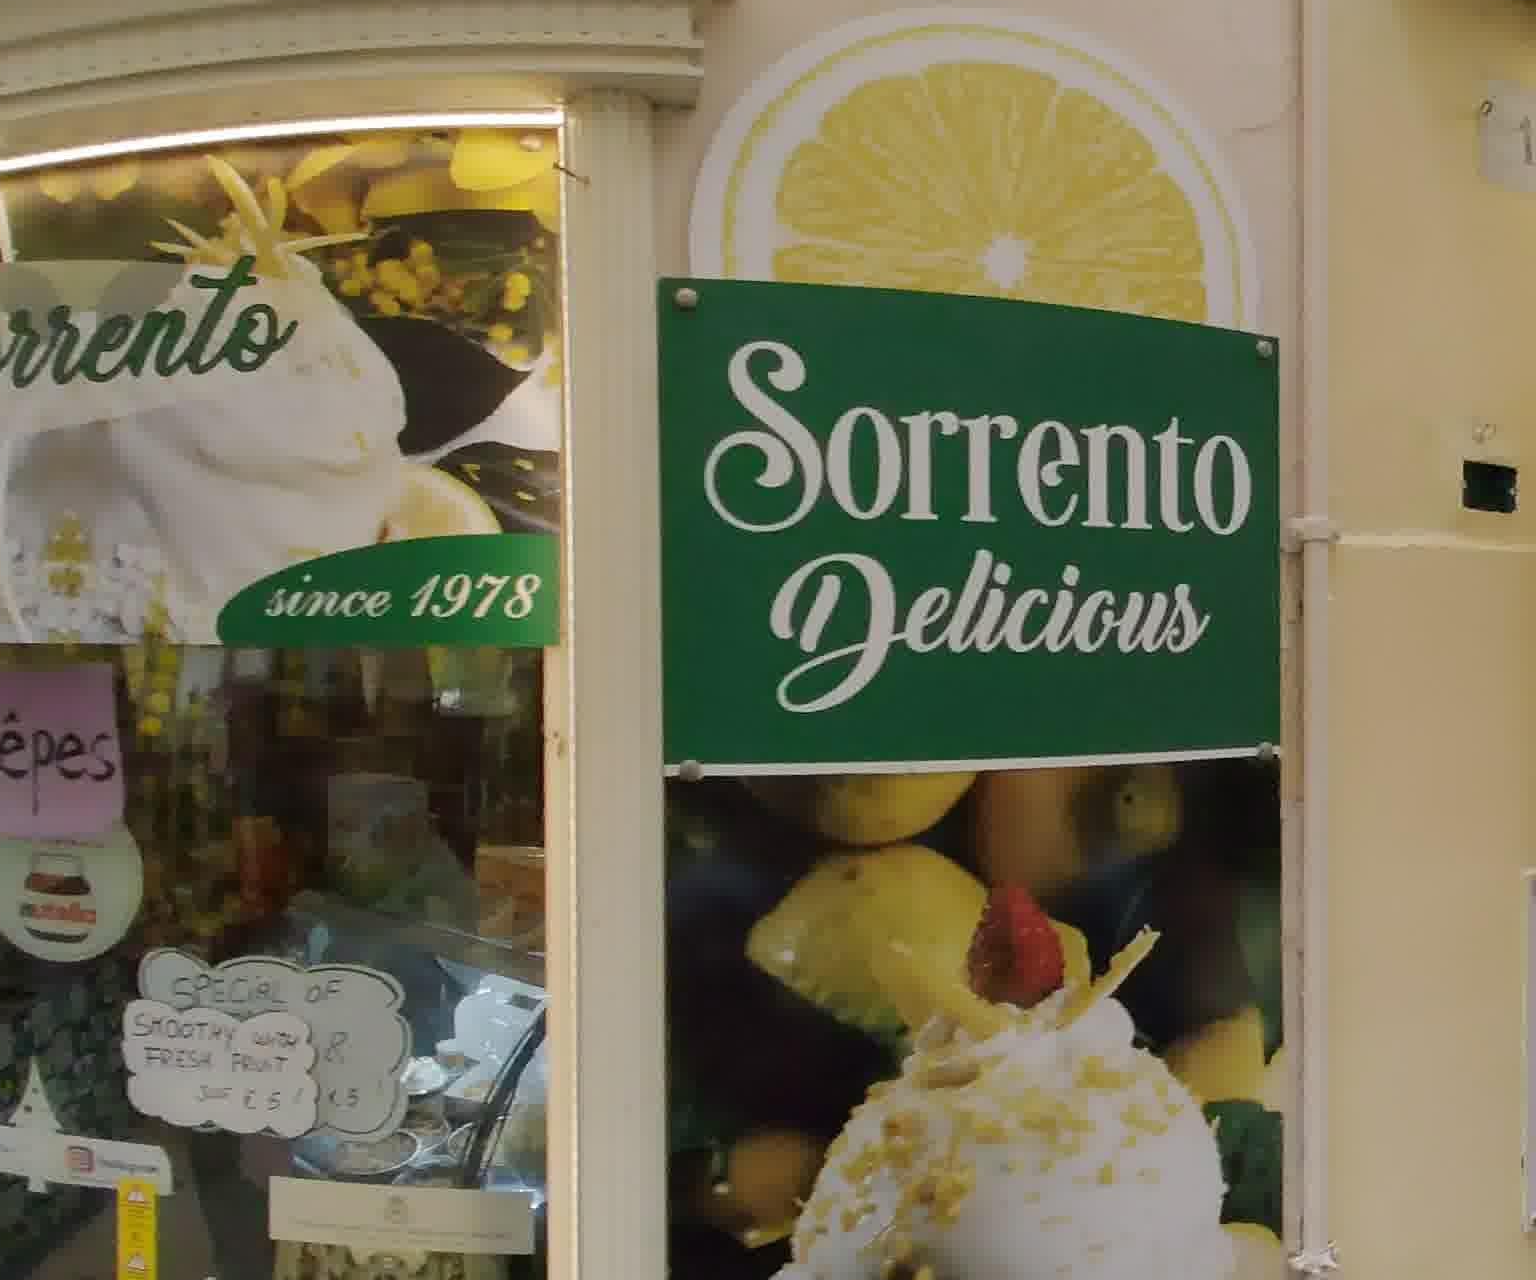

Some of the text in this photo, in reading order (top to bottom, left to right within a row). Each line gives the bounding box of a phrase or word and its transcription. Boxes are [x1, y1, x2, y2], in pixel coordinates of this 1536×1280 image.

[704, 341, 1252, 536] Sorrento
[266, 572, 542, 622] since 1978
[769, 549, 1211, 714] Delicious
